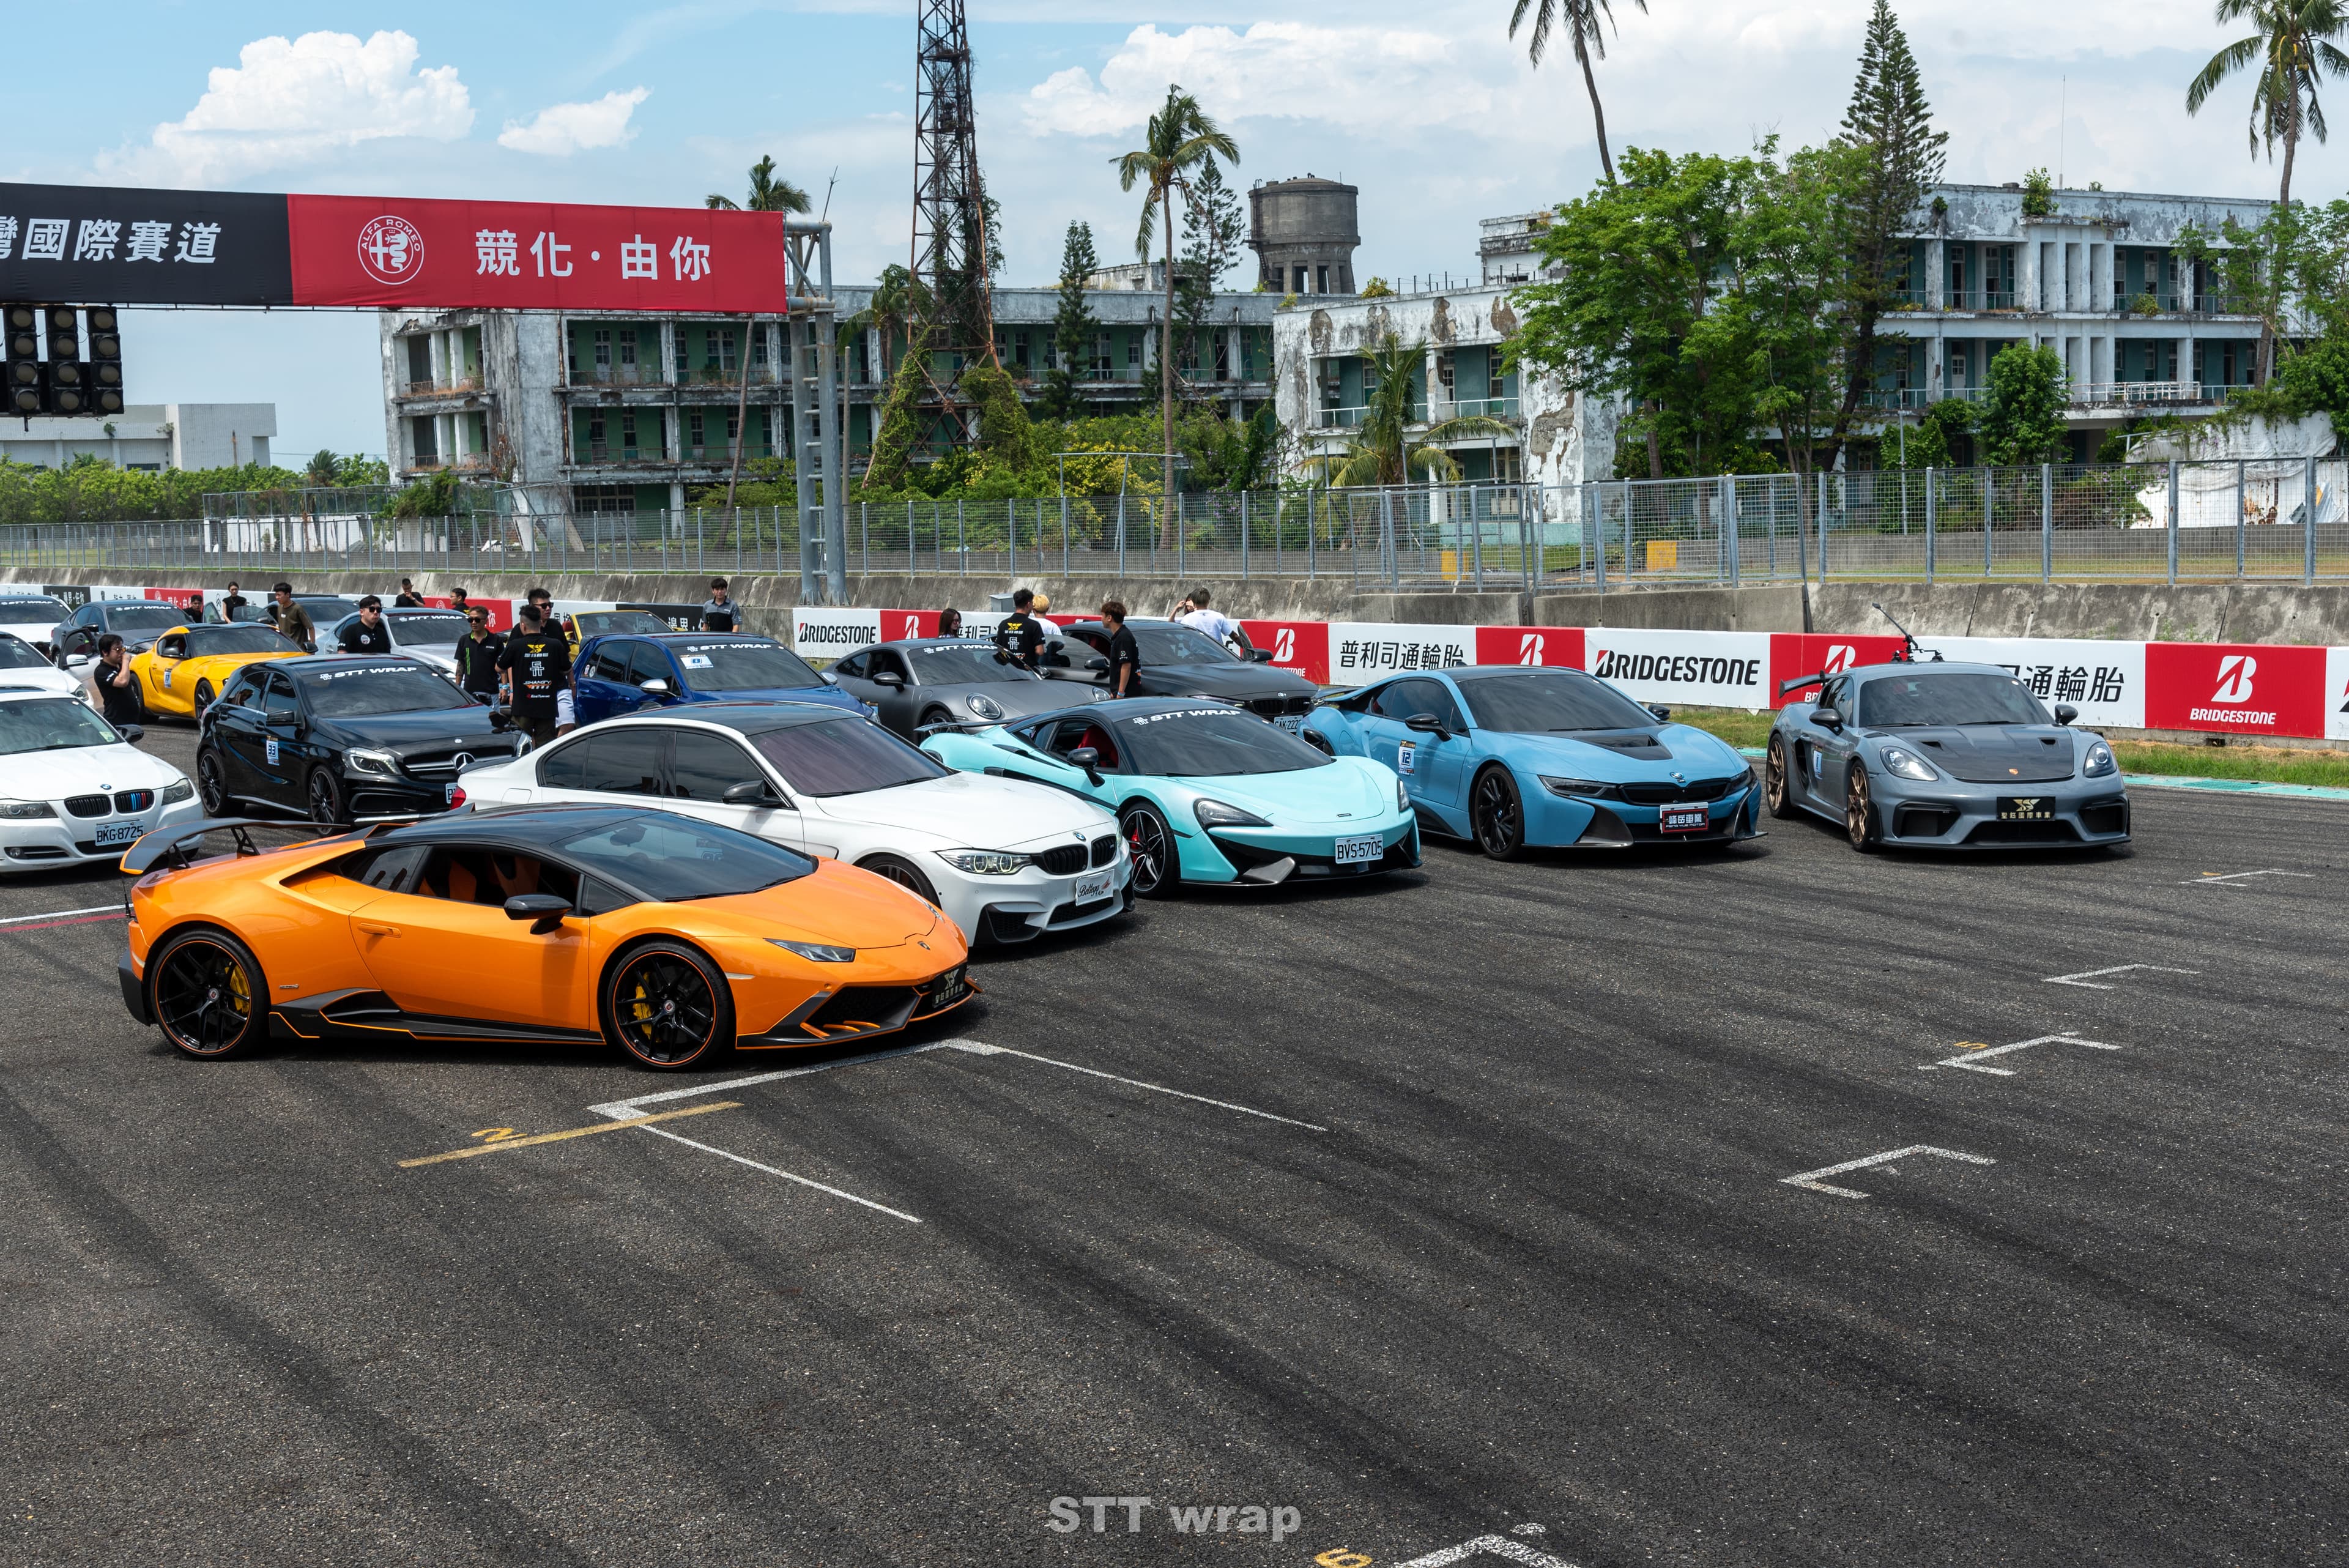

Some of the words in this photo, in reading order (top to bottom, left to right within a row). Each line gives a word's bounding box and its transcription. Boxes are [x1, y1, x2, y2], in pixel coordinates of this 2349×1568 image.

[362, 222, 381, 250] ALFA
[386, 219, 421, 251] ROMEO
[799, 623, 876, 644] BRIDGESTONE
[1340, 640, 1464, 671] 普利司通輪胎
[335, 669, 366, 678] STT
[1596, 650, 1761, 685] BRIDGESTONE
[1150, 712, 1184, 721] STT
[2189, 708, 2276, 724] BRIDGESTONE
[269, 745, 275, 756] 33
[1402, 751, 1411, 764] 12
[97, 825, 144, 842] BKG-8725
[1337, 840, 1382, 860] BVS-5705
